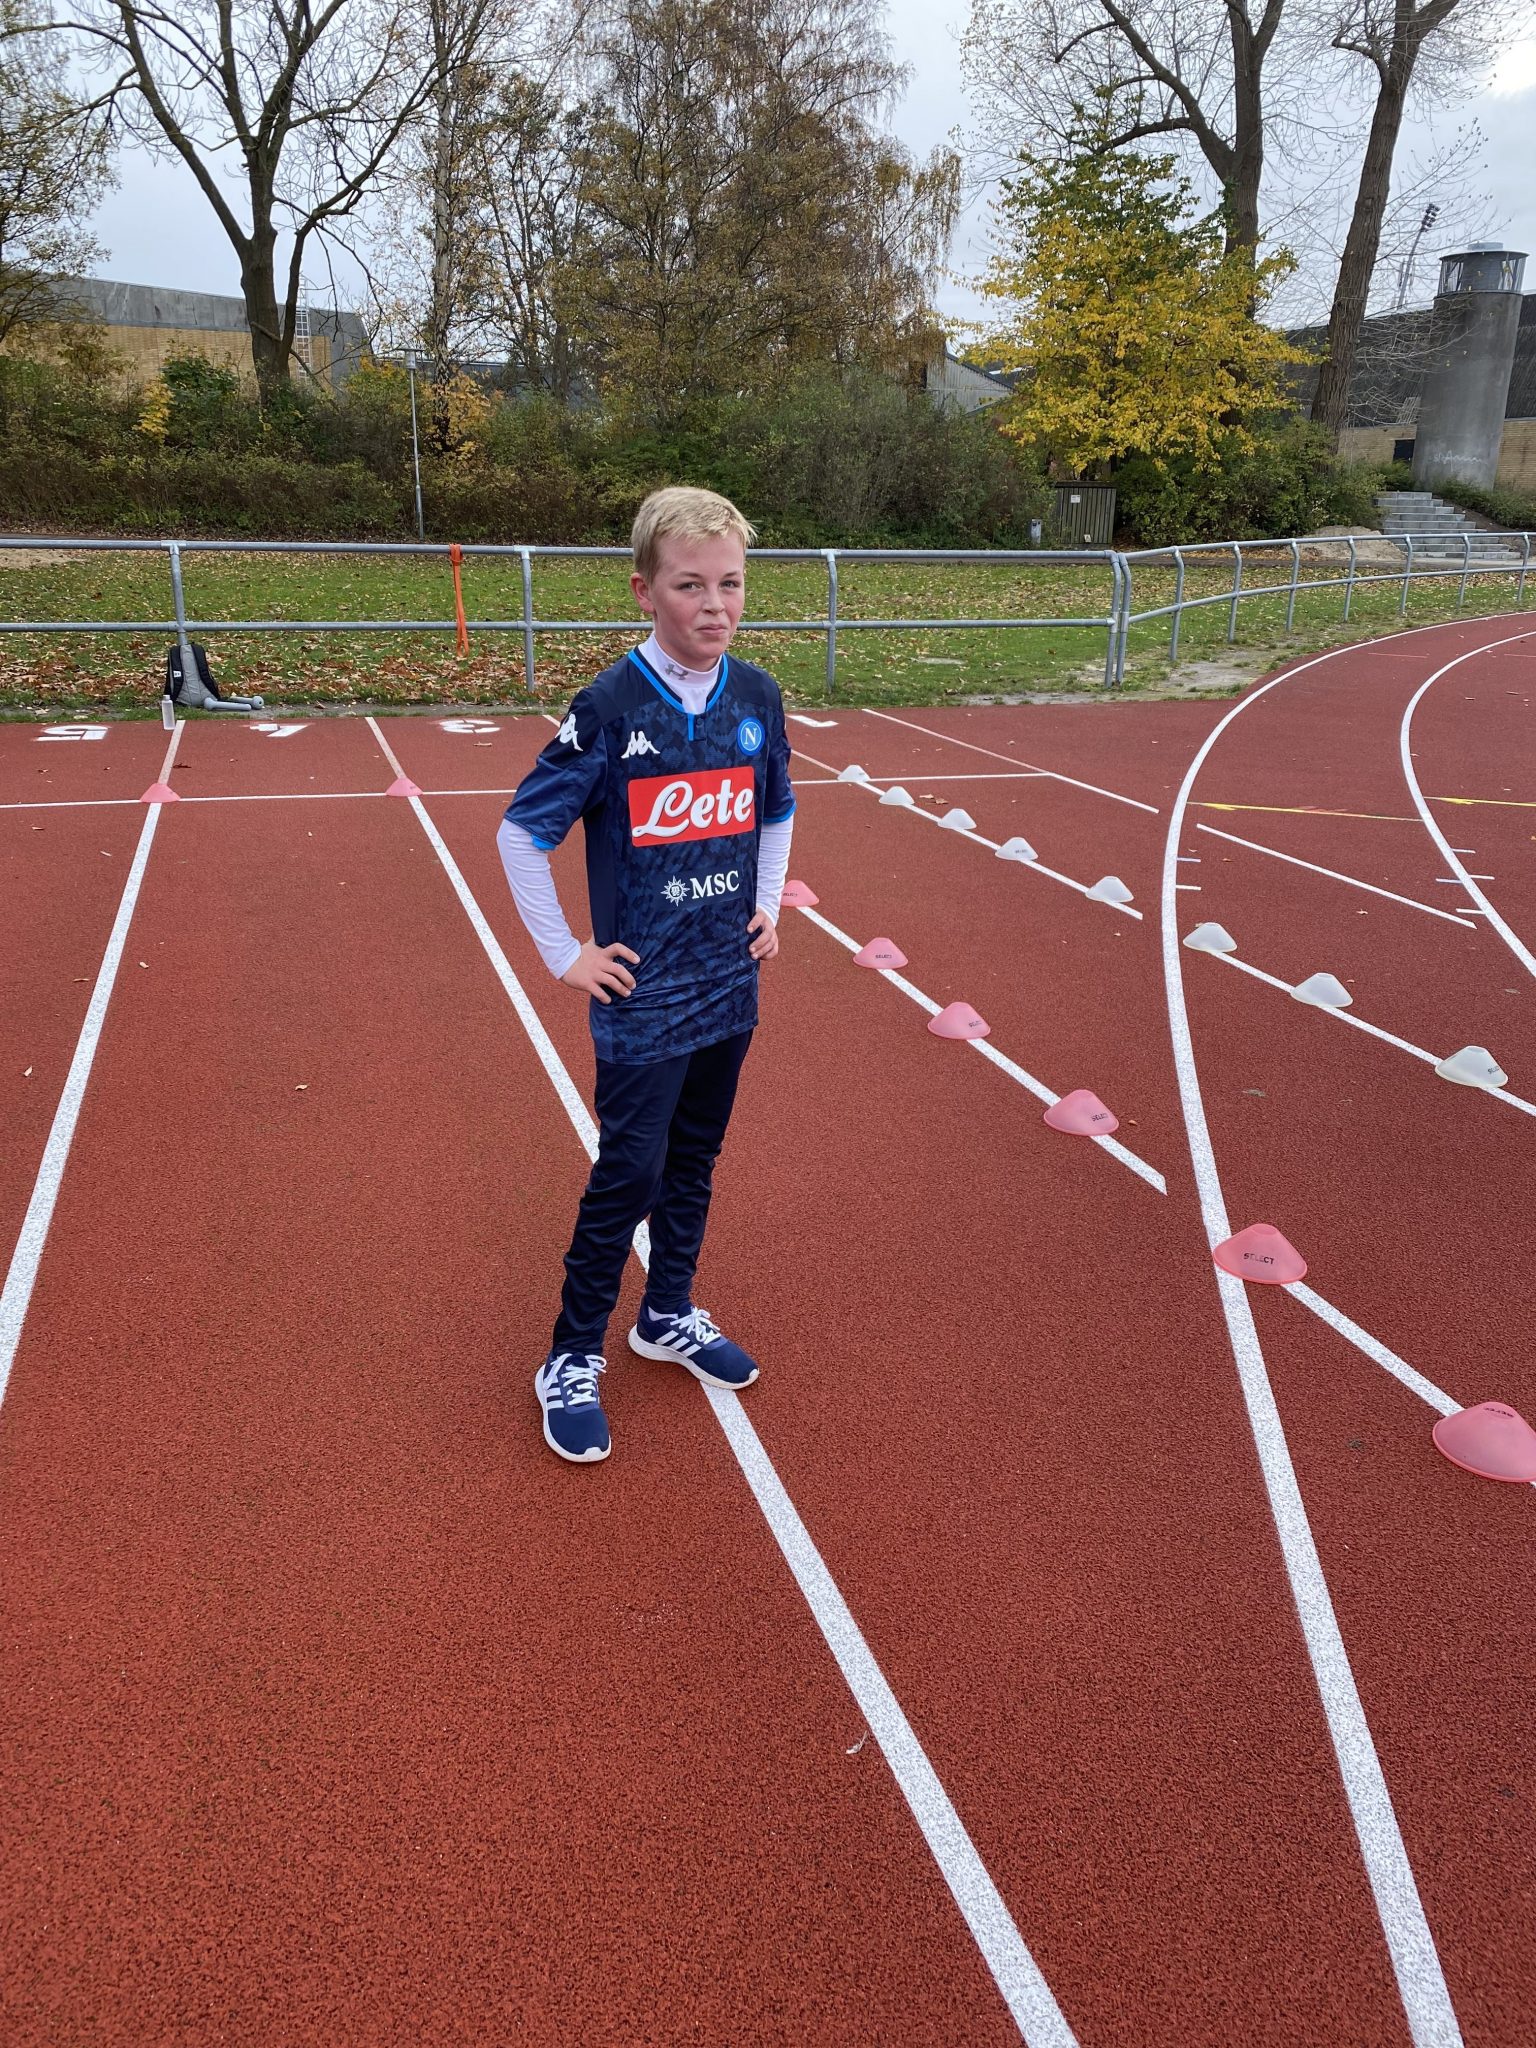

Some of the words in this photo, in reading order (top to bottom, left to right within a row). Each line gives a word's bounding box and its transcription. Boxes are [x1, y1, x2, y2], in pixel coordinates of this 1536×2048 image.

[37, 725, 108, 741] 5
[439, 719, 501, 733] 3
[744, 727, 758, 746] N
[632, 778, 754, 838] Lete
[689, 870, 740, 899] MSC
[1243, 1252, 1275, 1265] SELECT
